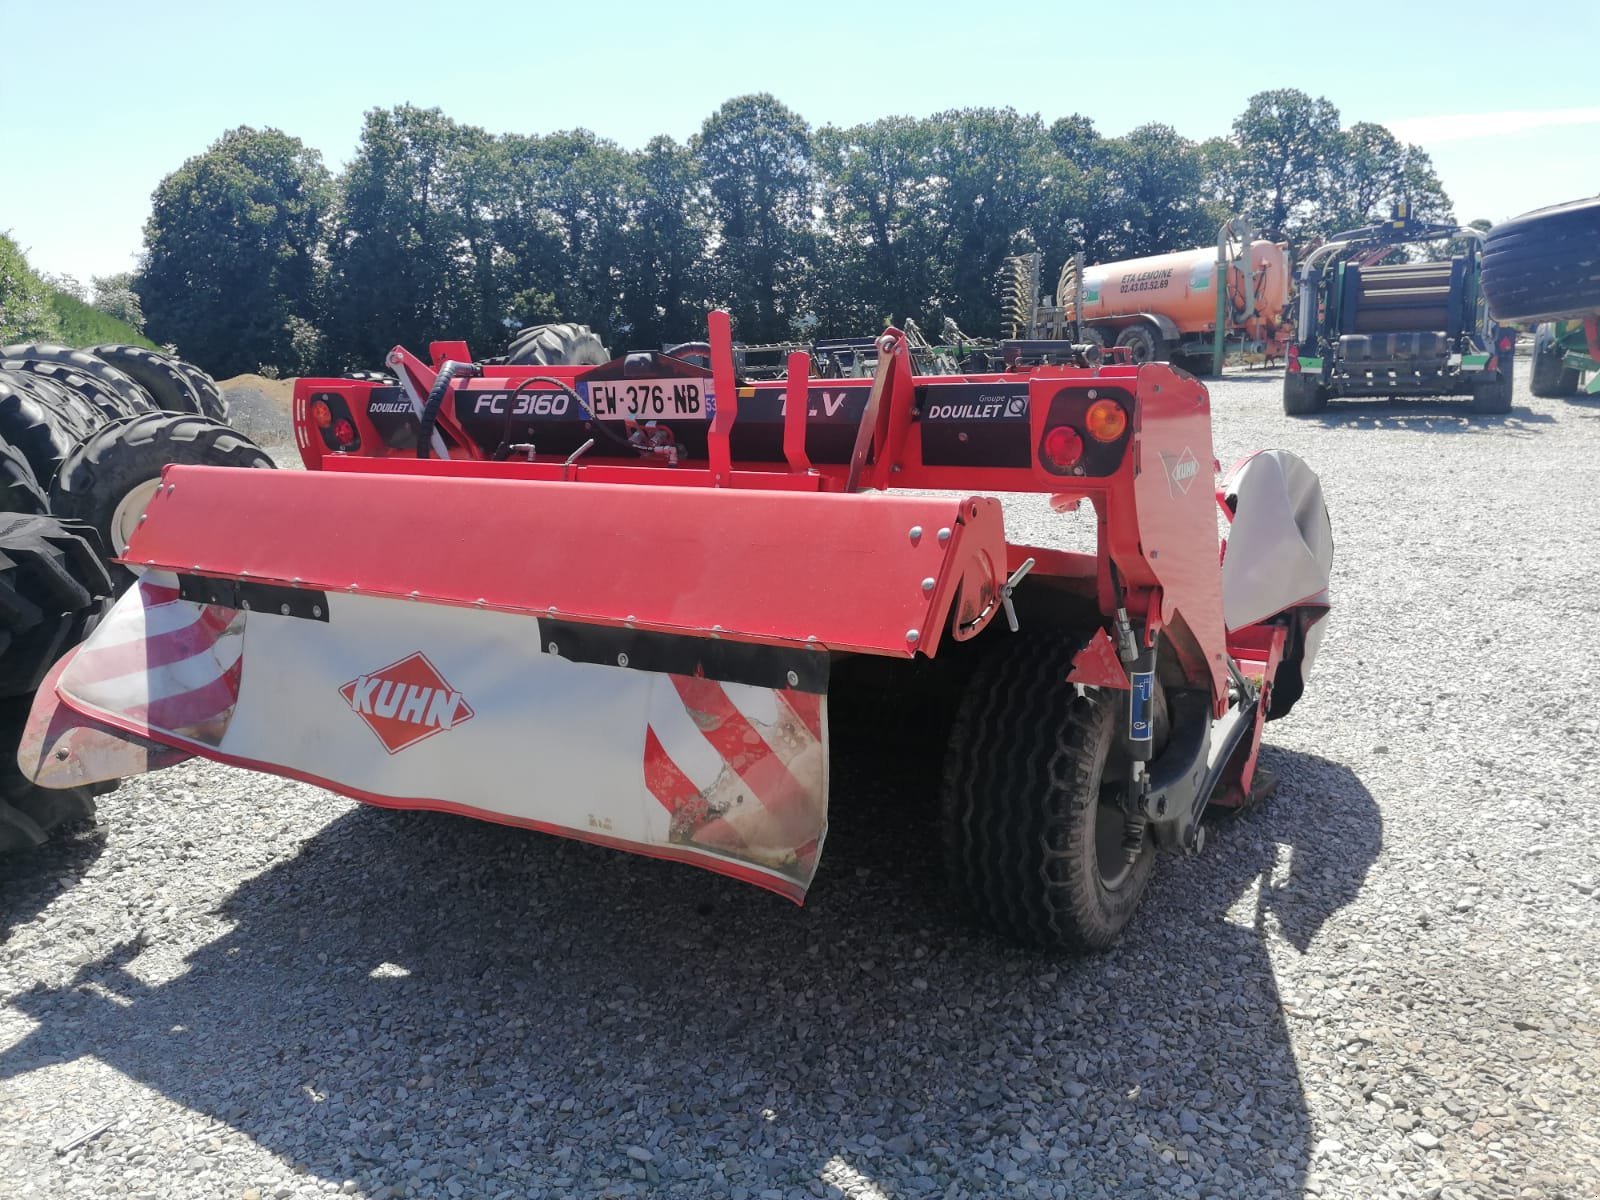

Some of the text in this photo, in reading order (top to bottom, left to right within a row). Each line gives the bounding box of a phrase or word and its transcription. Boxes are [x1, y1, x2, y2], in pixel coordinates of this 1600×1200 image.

[1121, 268, 1173, 284] ETA LEMOINE
[474, 394, 569, 415] FC 3160
[592, 384, 700, 414] EW-376-NB
[979, 394, 1005, 403] Groupe
[370, 402, 409, 412] DOUILLET
[929, 405, 1002, 418] DOUILLET
[352, 675, 461, 730] KUHN
